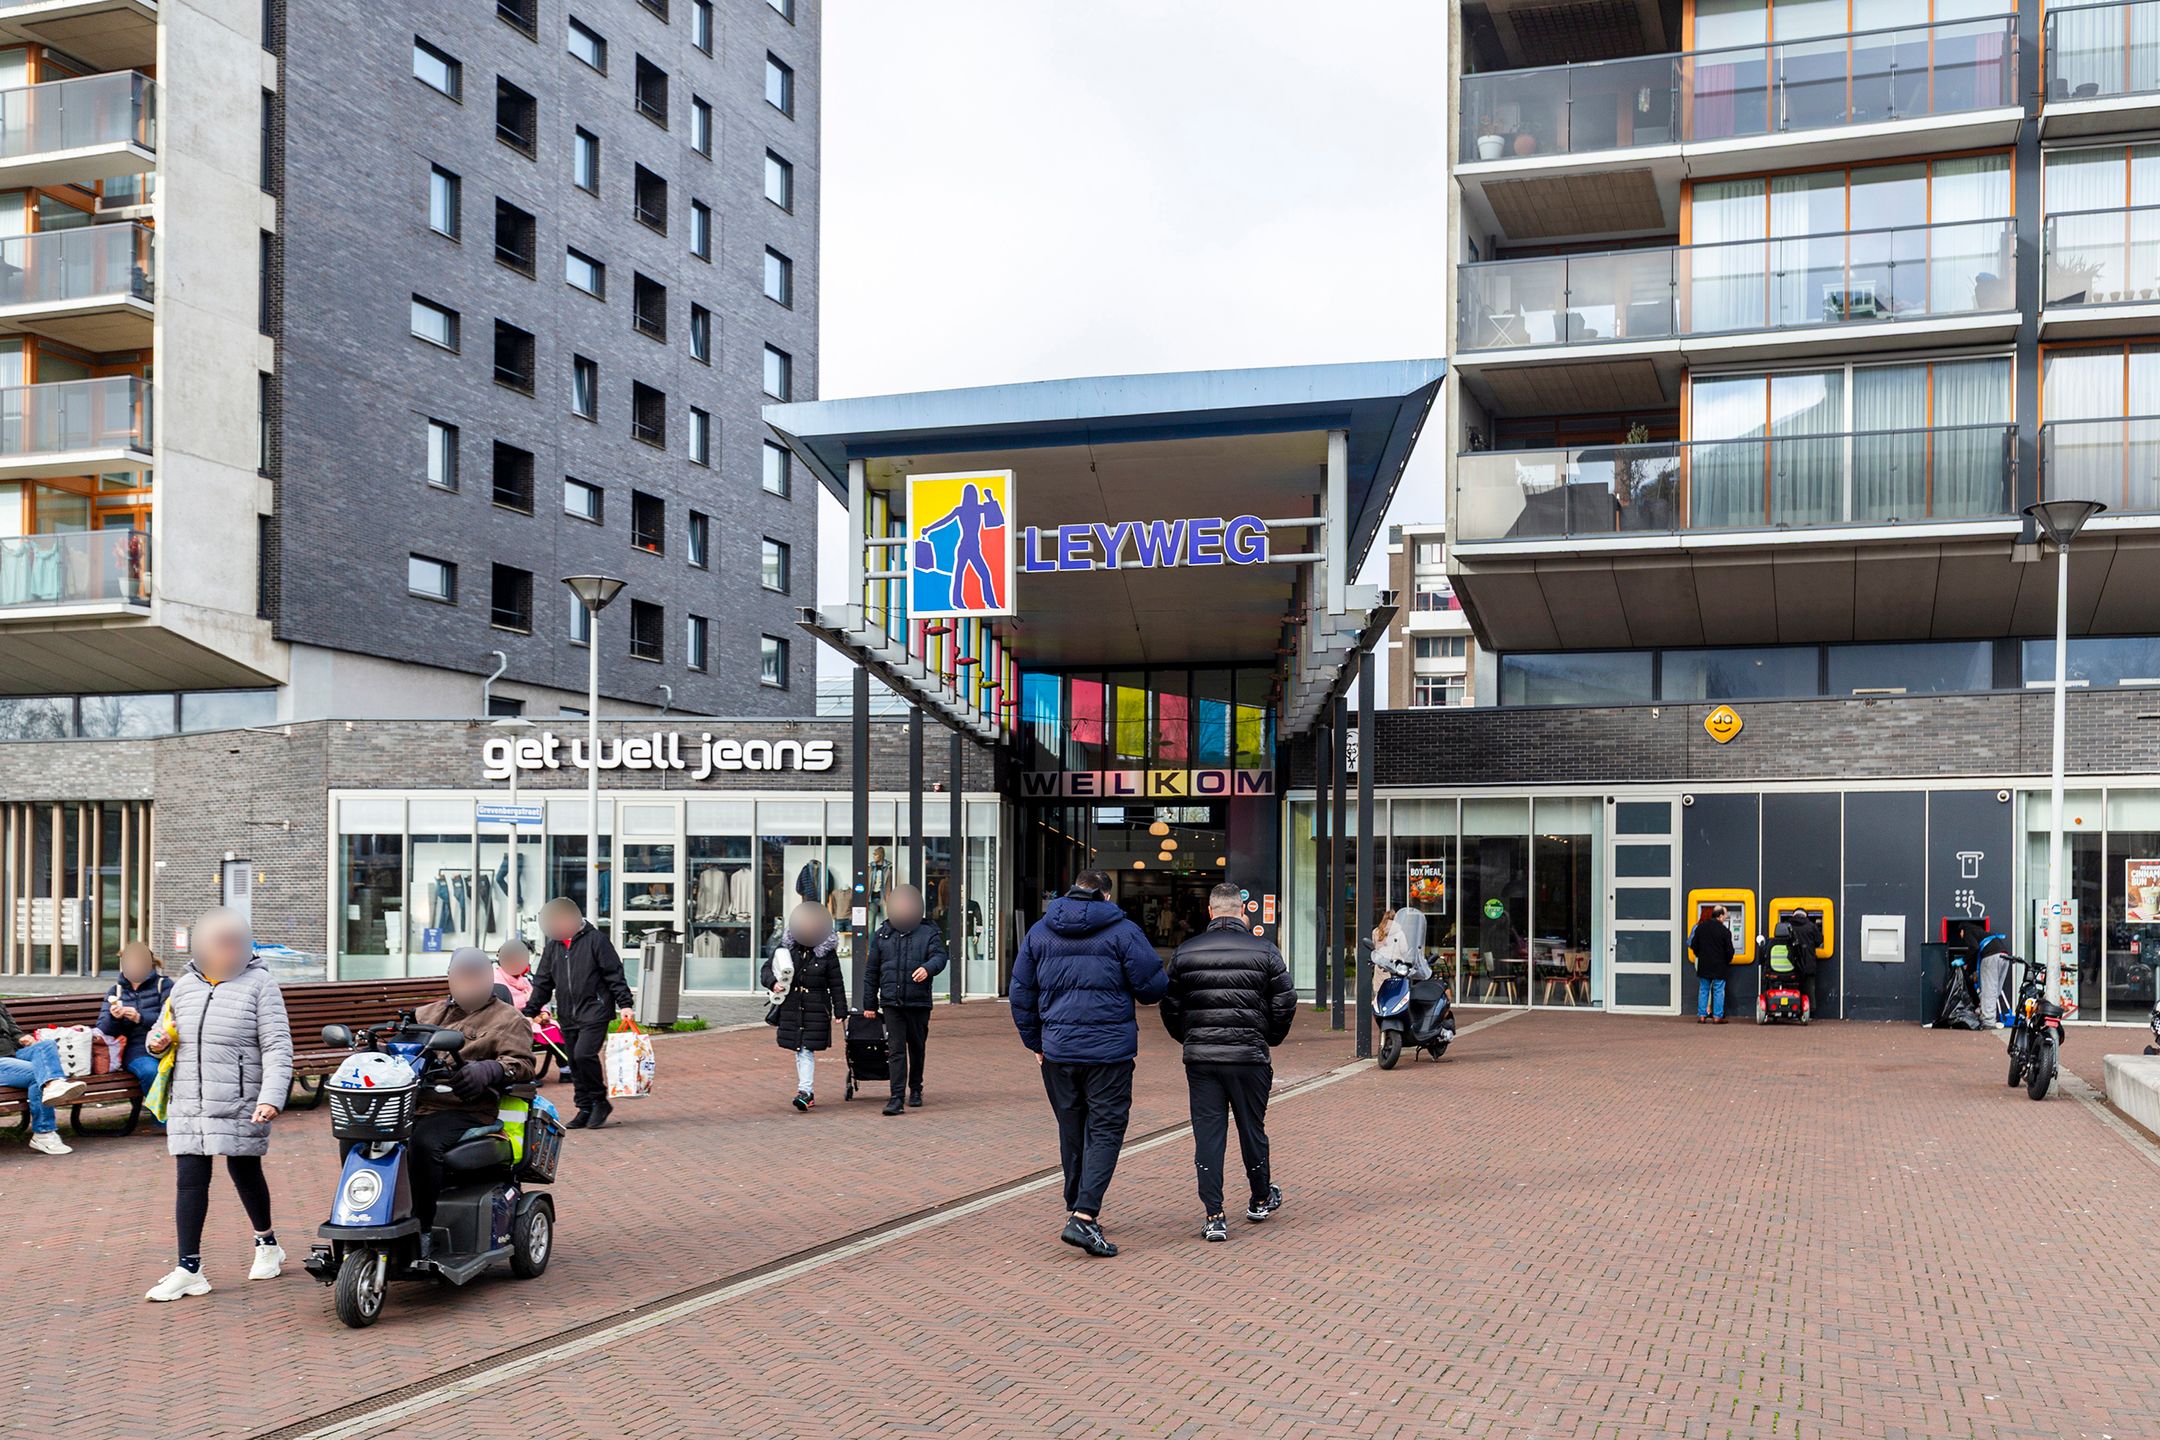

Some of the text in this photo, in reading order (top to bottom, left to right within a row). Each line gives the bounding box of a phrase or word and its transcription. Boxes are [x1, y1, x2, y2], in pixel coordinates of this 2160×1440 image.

[1025, 515, 1269, 572] LEYWEG
[483, 732, 834, 780] get well jeans
[1022, 771, 1273, 795] WELKOM
[1410, 868, 1442, 876] BOX MEAL
[2132, 878, 2147, 886] BUN
